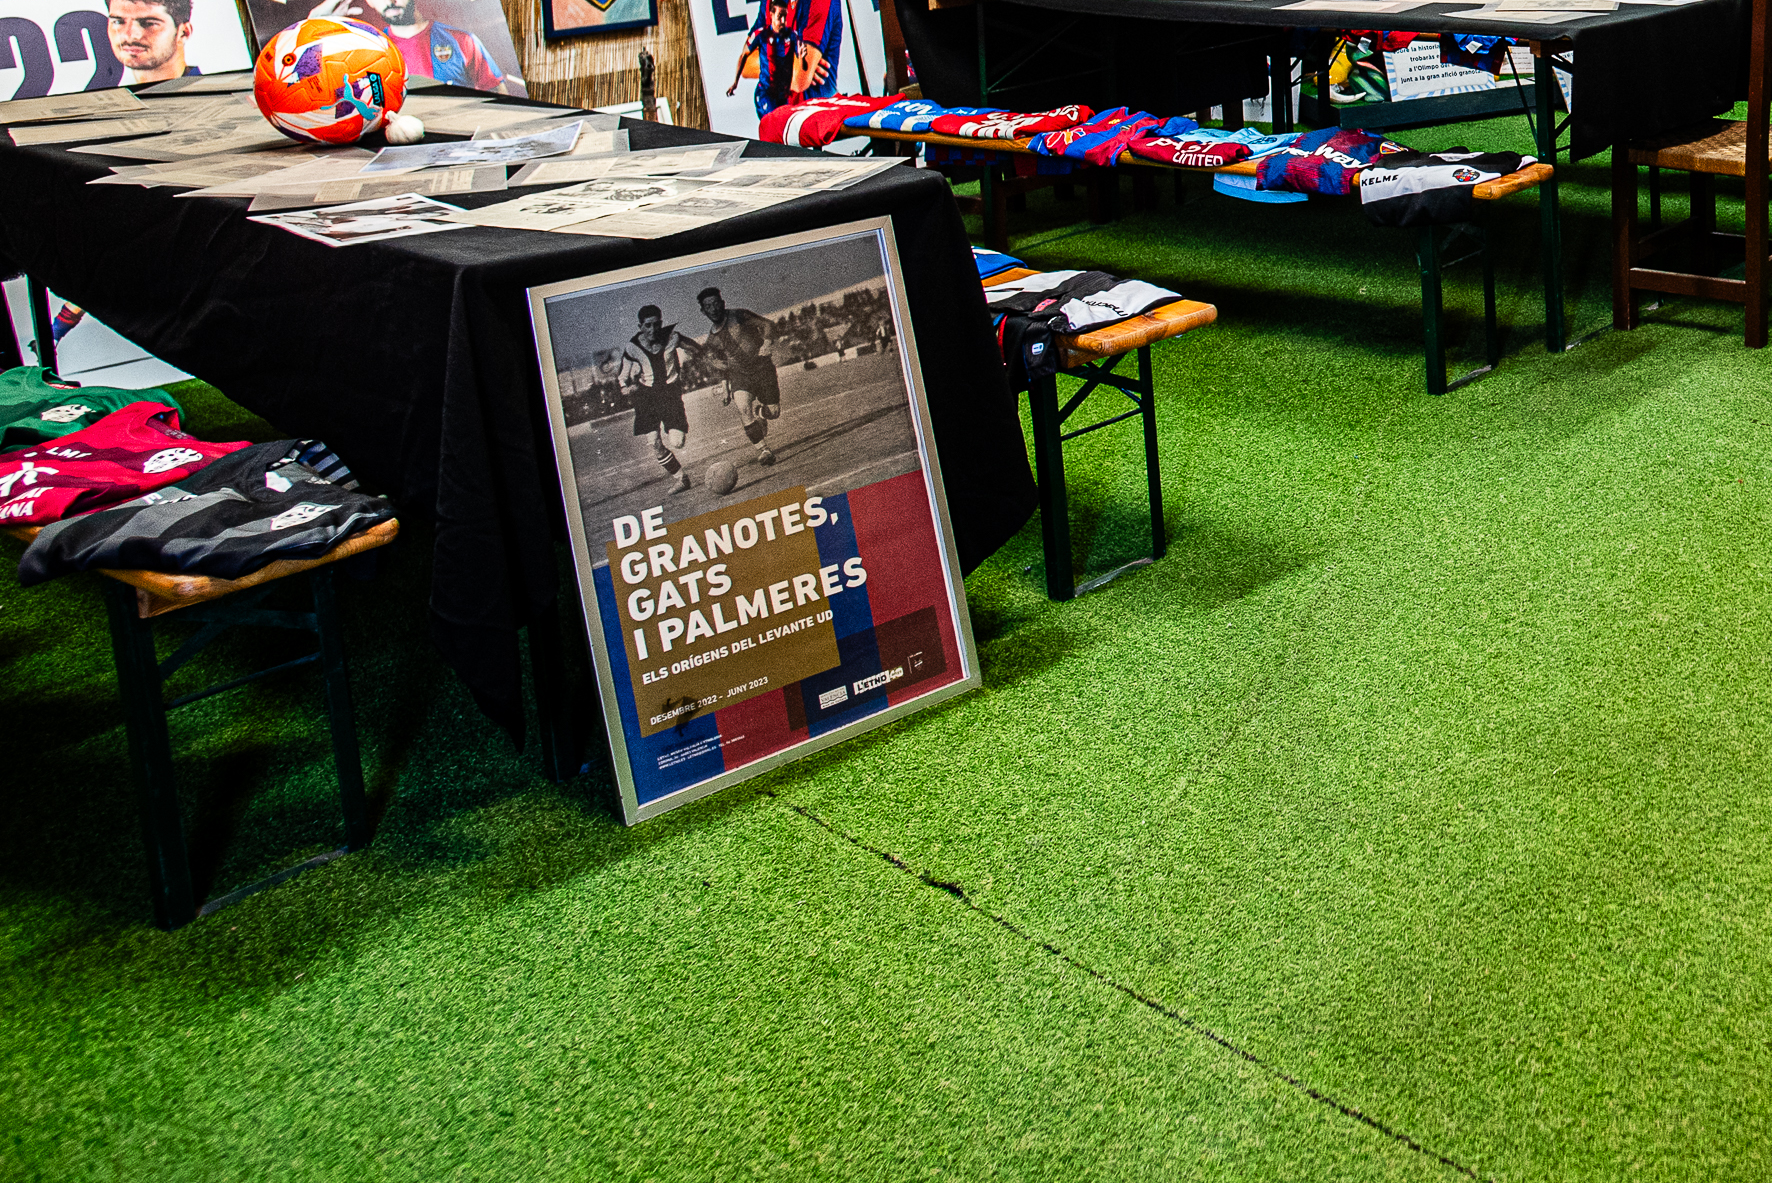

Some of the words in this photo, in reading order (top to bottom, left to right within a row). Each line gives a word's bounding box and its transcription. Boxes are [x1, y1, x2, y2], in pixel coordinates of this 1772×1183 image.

[1401, 76, 1413, 84] junt
[1172, 150, 1224, 167] UNITED
[1361, 173, 1399, 187] KELME
[613, 505, 668, 549] DE
[620, 496, 839, 585] GRANOTES,
[626, 564, 733, 622] GATS
[633, 627, 648, 660] I
[658, 557, 868, 653] PALMERES
[642, 667, 669, 685] ELS
[671, 646, 729, 677] ORÍGENS
[732, 638, 756, 656] DEL
[759, 619, 815, 645] LEVANTE
[817, 609, 834, 626] UD
[650, 699, 696, 726] DESEMBRE
[697, 693, 718, 710] 2022
[726, 683, 747, 699] JUNY
[749, 676, 769, 692] 2023
